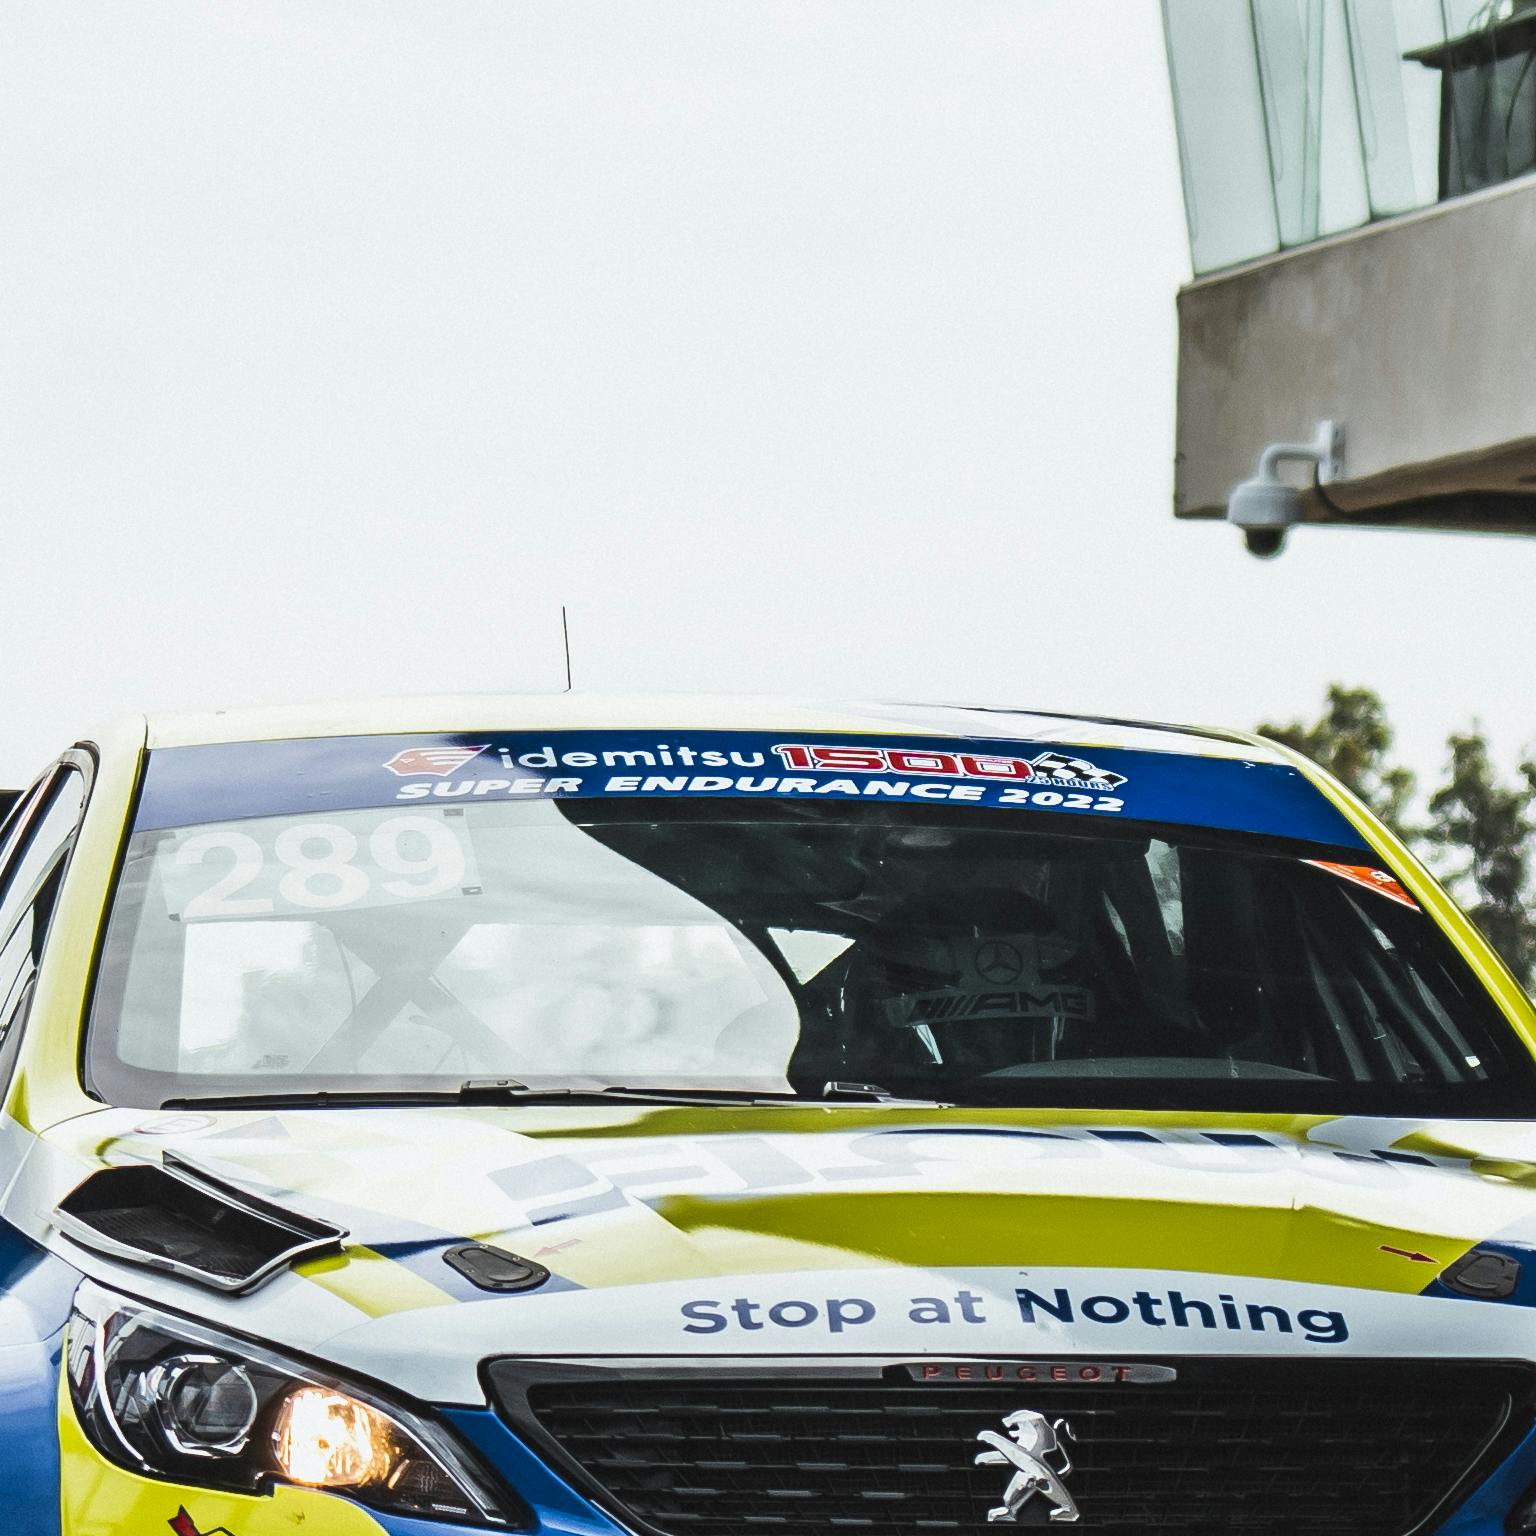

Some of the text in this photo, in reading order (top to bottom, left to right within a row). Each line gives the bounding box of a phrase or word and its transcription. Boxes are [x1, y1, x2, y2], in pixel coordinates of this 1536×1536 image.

[499, 744, 1037, 782] idemitsu 1500
[396, 776, 1125, 812] SUPER ENDURANCE 2022
[175, 815, 466, 918] 289
[681, 1288, 1350, 1344] Stop at Nothing
[923, 1365, 1133, 1382] PEUGEOT
